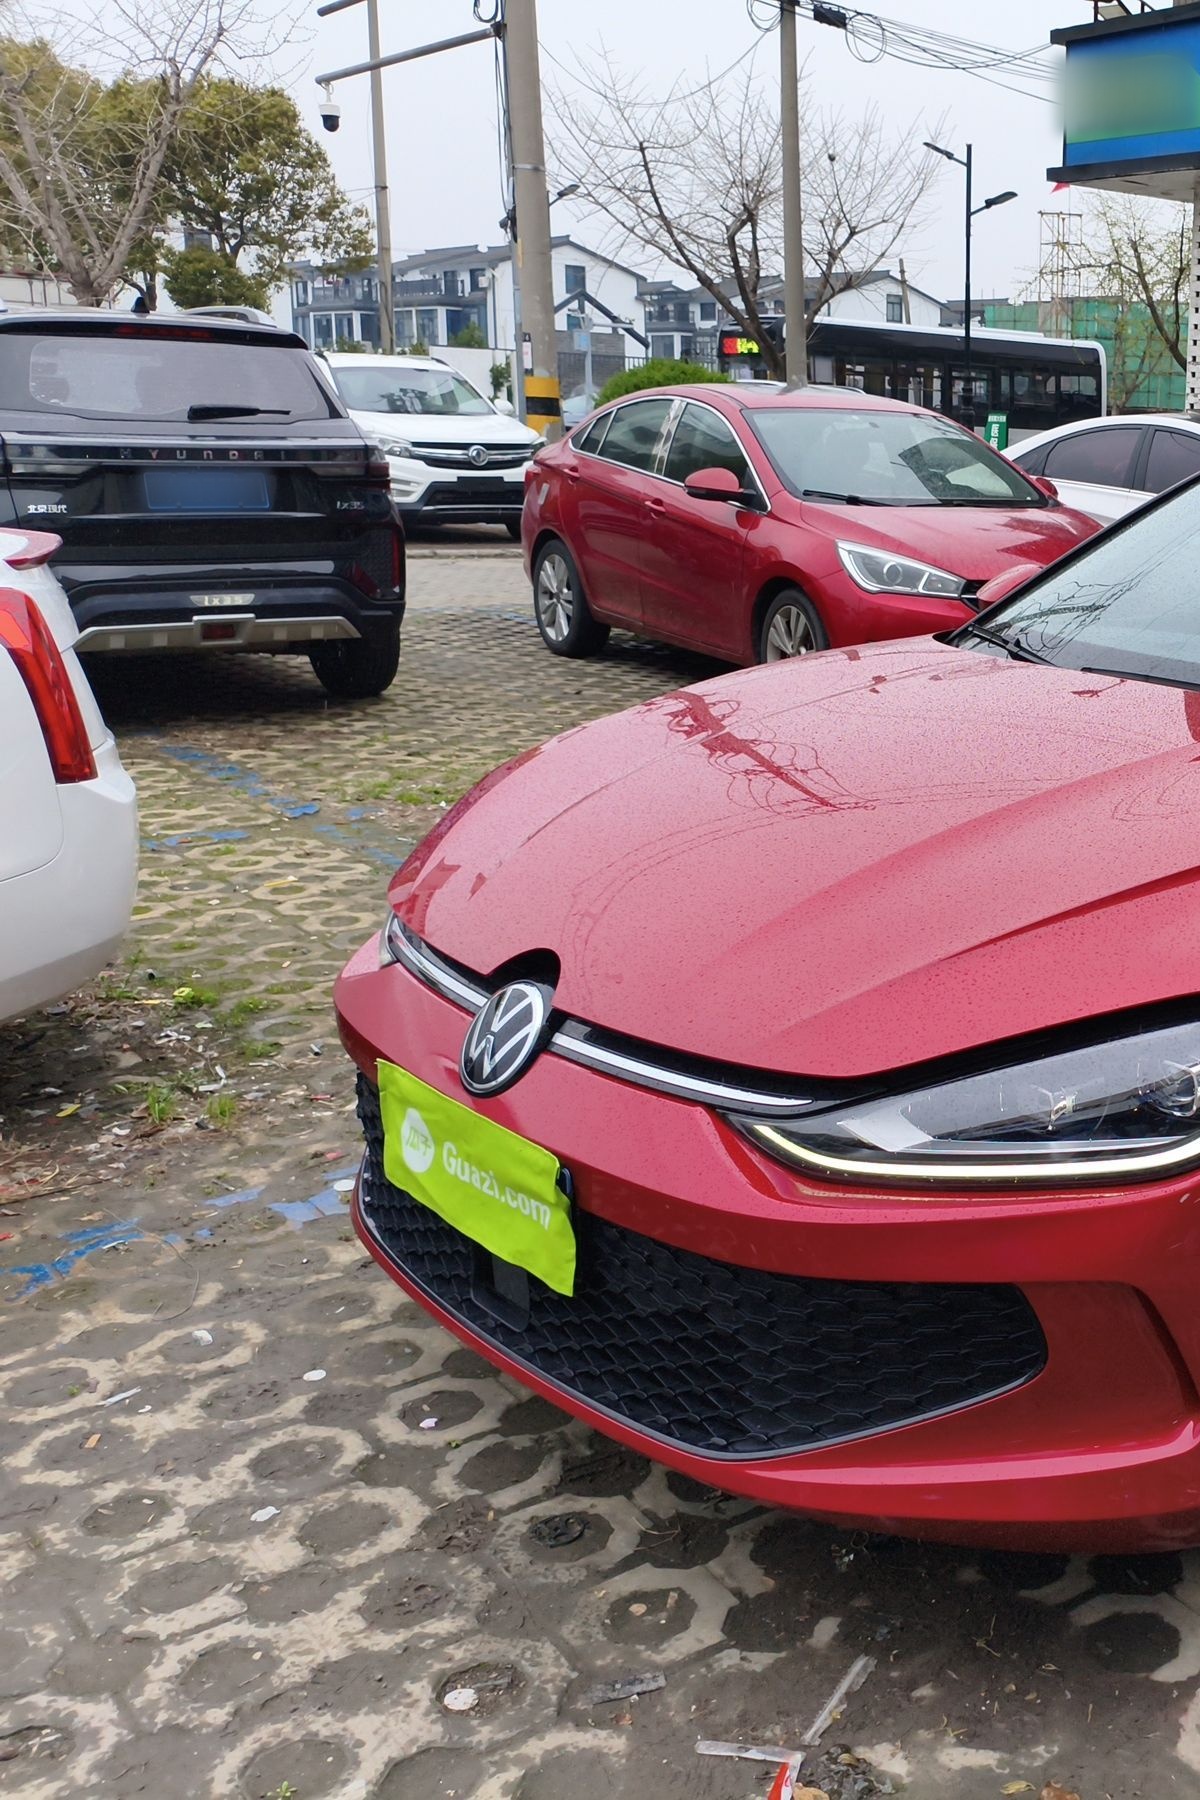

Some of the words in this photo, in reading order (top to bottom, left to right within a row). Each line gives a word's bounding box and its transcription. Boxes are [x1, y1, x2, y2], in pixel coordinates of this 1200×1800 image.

[120, 449, 286, 460] HYUNDAI
[27, 504, 68, 514] 北京现代
[442, 1141, 552, 1231] Guazi.com
